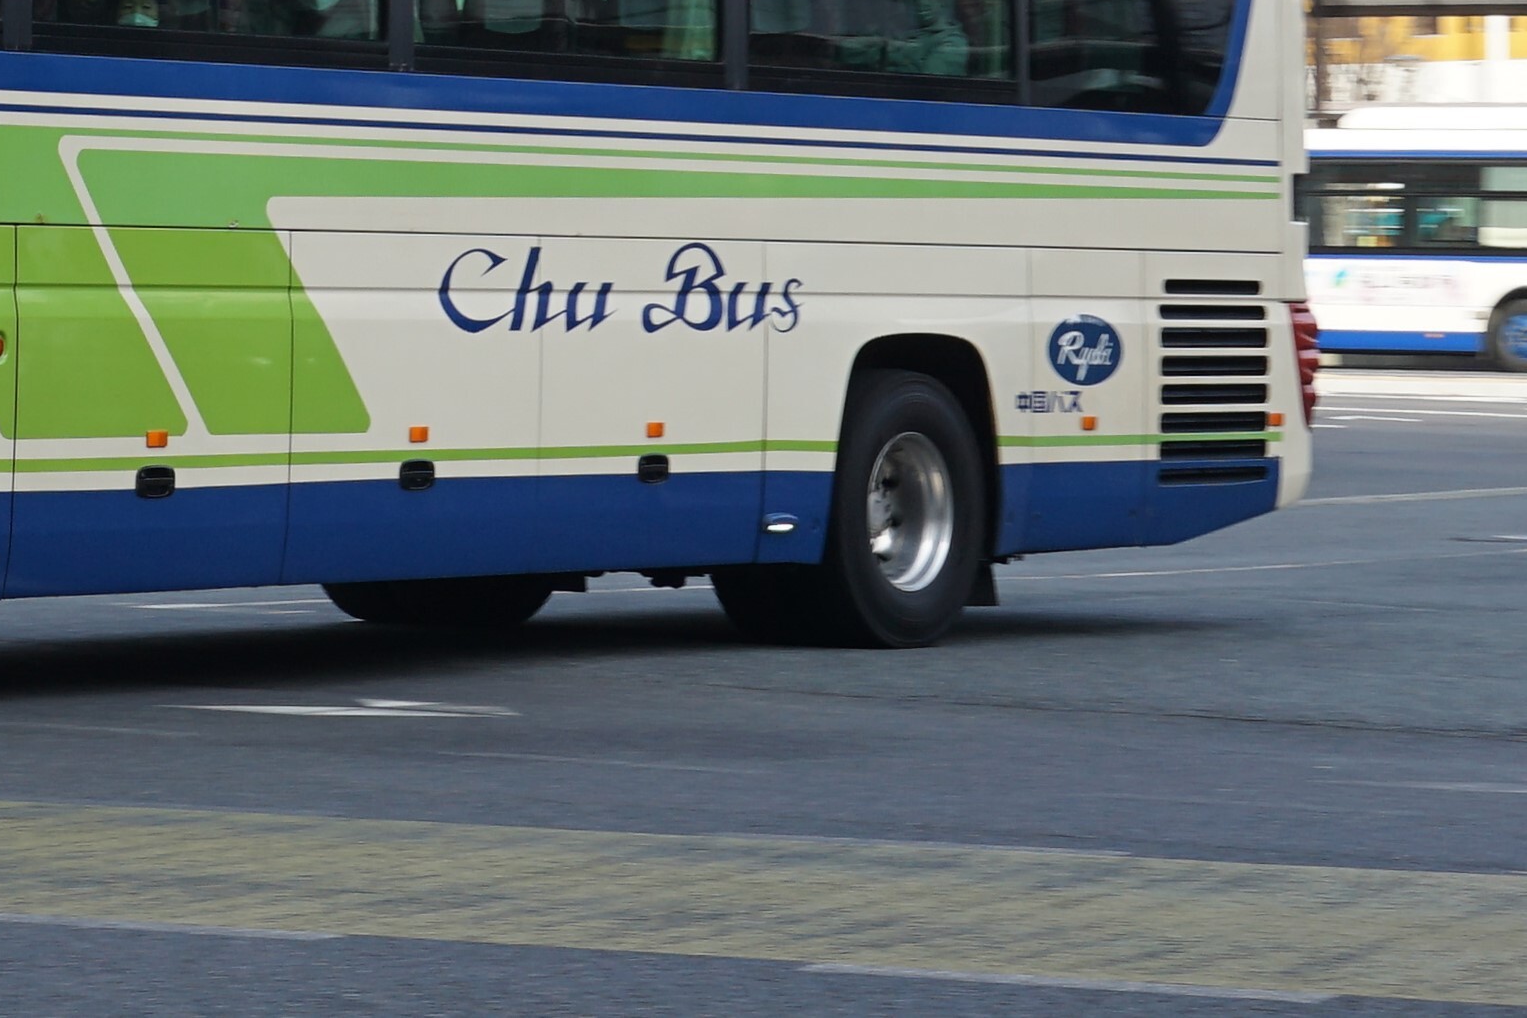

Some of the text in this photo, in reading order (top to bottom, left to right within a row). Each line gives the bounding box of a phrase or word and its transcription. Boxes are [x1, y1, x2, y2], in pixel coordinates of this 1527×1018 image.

[438, 242, 805, 334] Chu Bus
[1015, 390, 1084, 413] 中国バス
